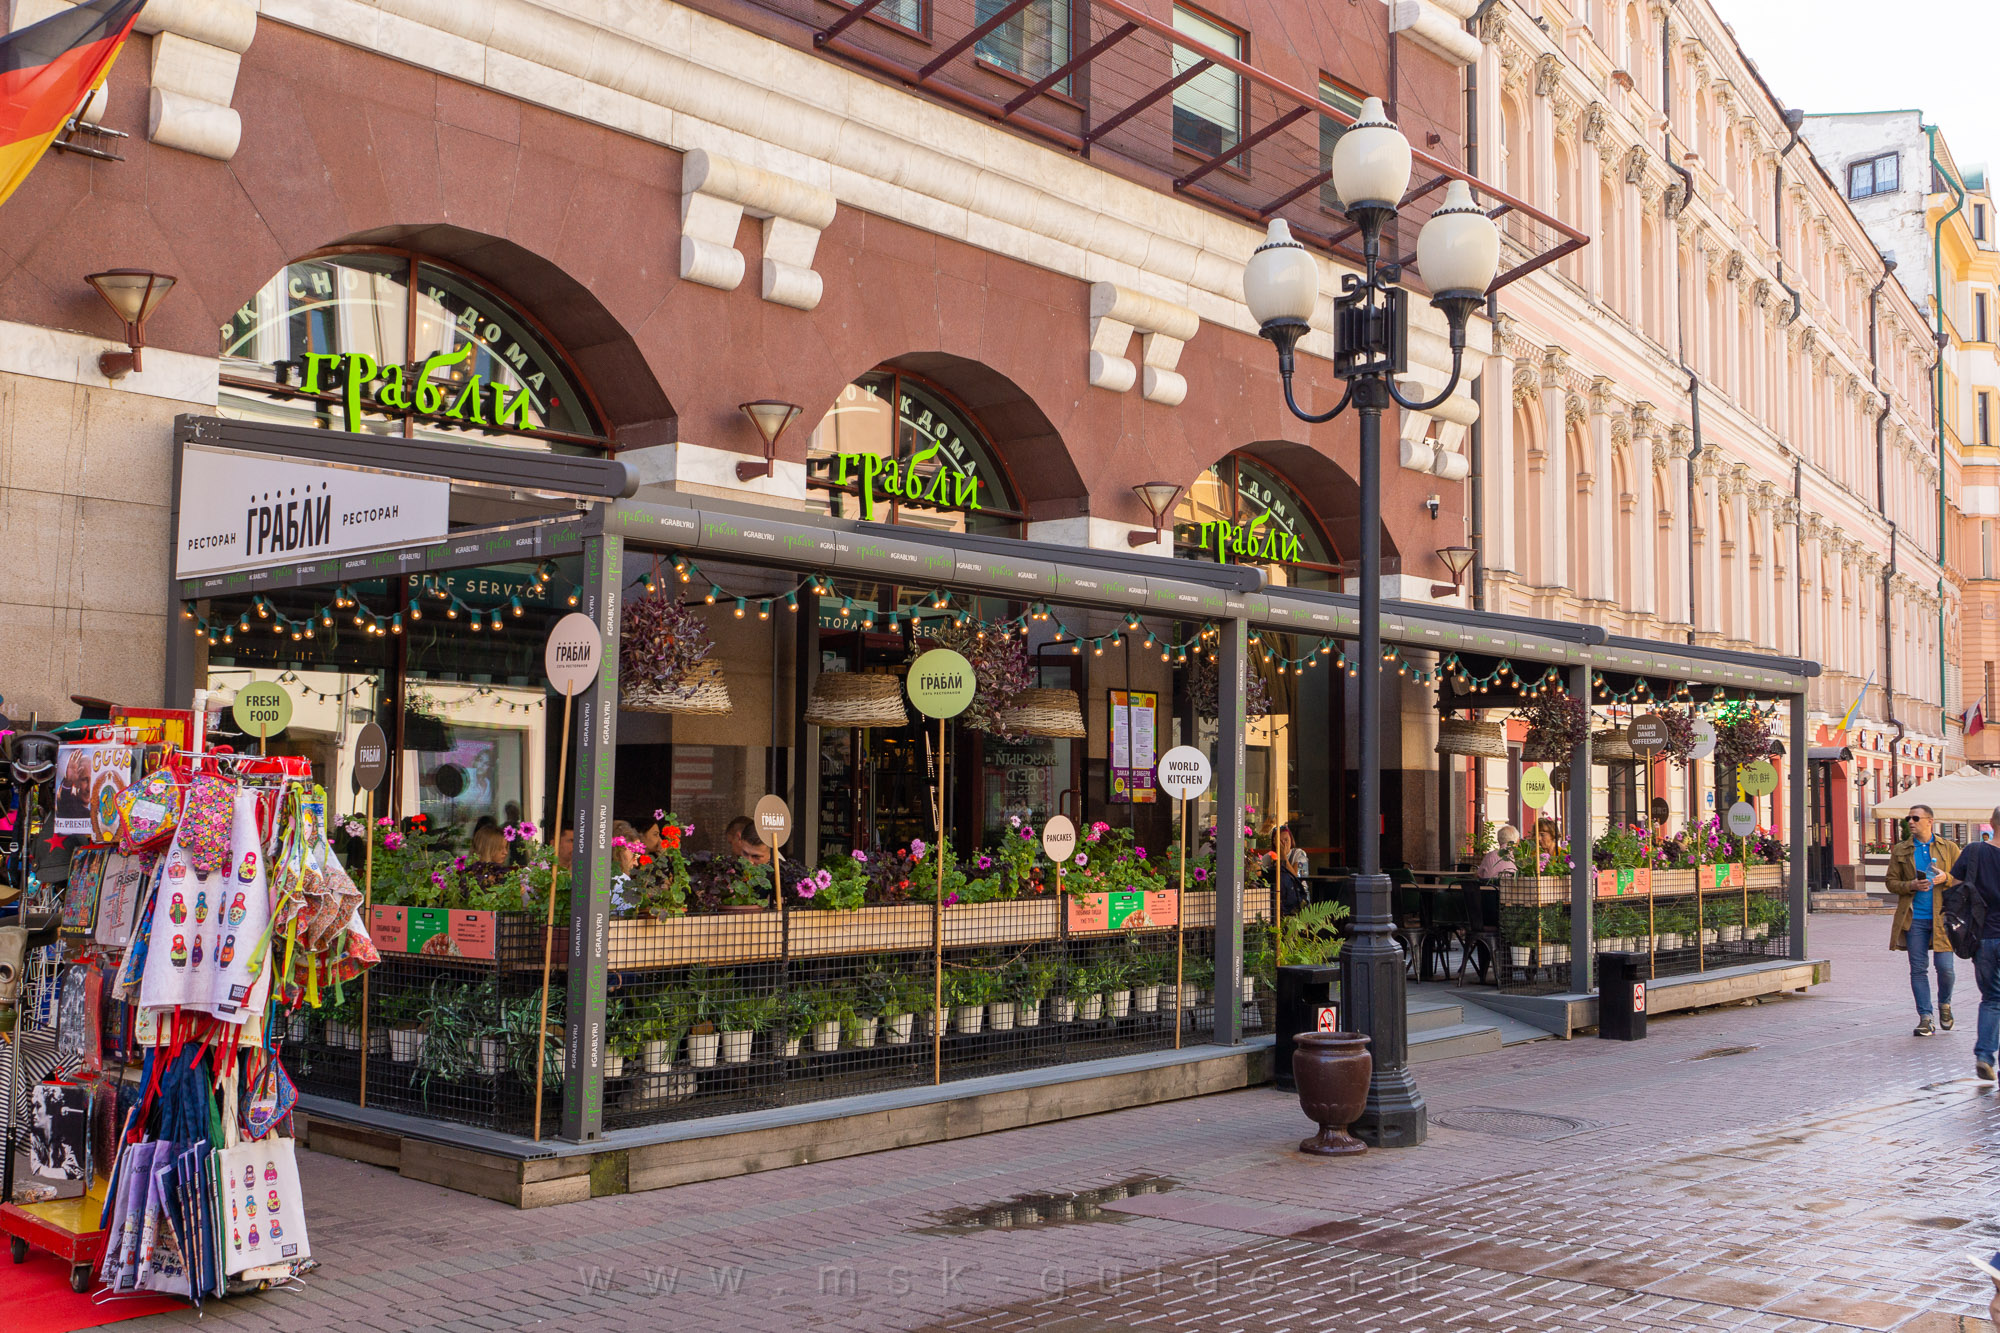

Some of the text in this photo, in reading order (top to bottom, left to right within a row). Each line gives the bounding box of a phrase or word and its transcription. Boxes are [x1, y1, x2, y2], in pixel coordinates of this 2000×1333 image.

[456, 306, 547, 392] ДОМА
[916, 411, 977, 477] ДОМА
[188, 481, 399, 556] РЕСТОРАН ГРАБЛИ РЕСТОРАН
[1247, 480, 1295, 531] ДОМА
[660, 518, 695, 529] #GRABLYRU
[743, 530, 775, 541] #GRABLYRU
[890, 552, 918, 562] #GRABLYRU
[466, 580, 546, 600] SERVICE
[607, 592, 616, 637] #GRABLYRU
[556, 644, 591, 661] ГРАБЛИ
[920, 674, 963, 690] ГРАБЛИ
[246, 695, 280, 707] FRESH
[250, 710, 279, 722] FOOD
[603, 700, 611, 745] #GRABLYRU
[1636, 723, 1657, 731] ITALIAN
[1167, 774, 1203, 785] KITCHEN
[1168, 761, 1200, 771] WORLD
[1525, 781, 1546, 791] ГРАБЛИ
[599, 804, 608, 849] #GRABLYRU
[1046, 833, 1073, 843] PANCAKES
[595, 913, 604, 958] #GRABLYRU
[591, 1022, 599, 1069] #GRABLYRU
